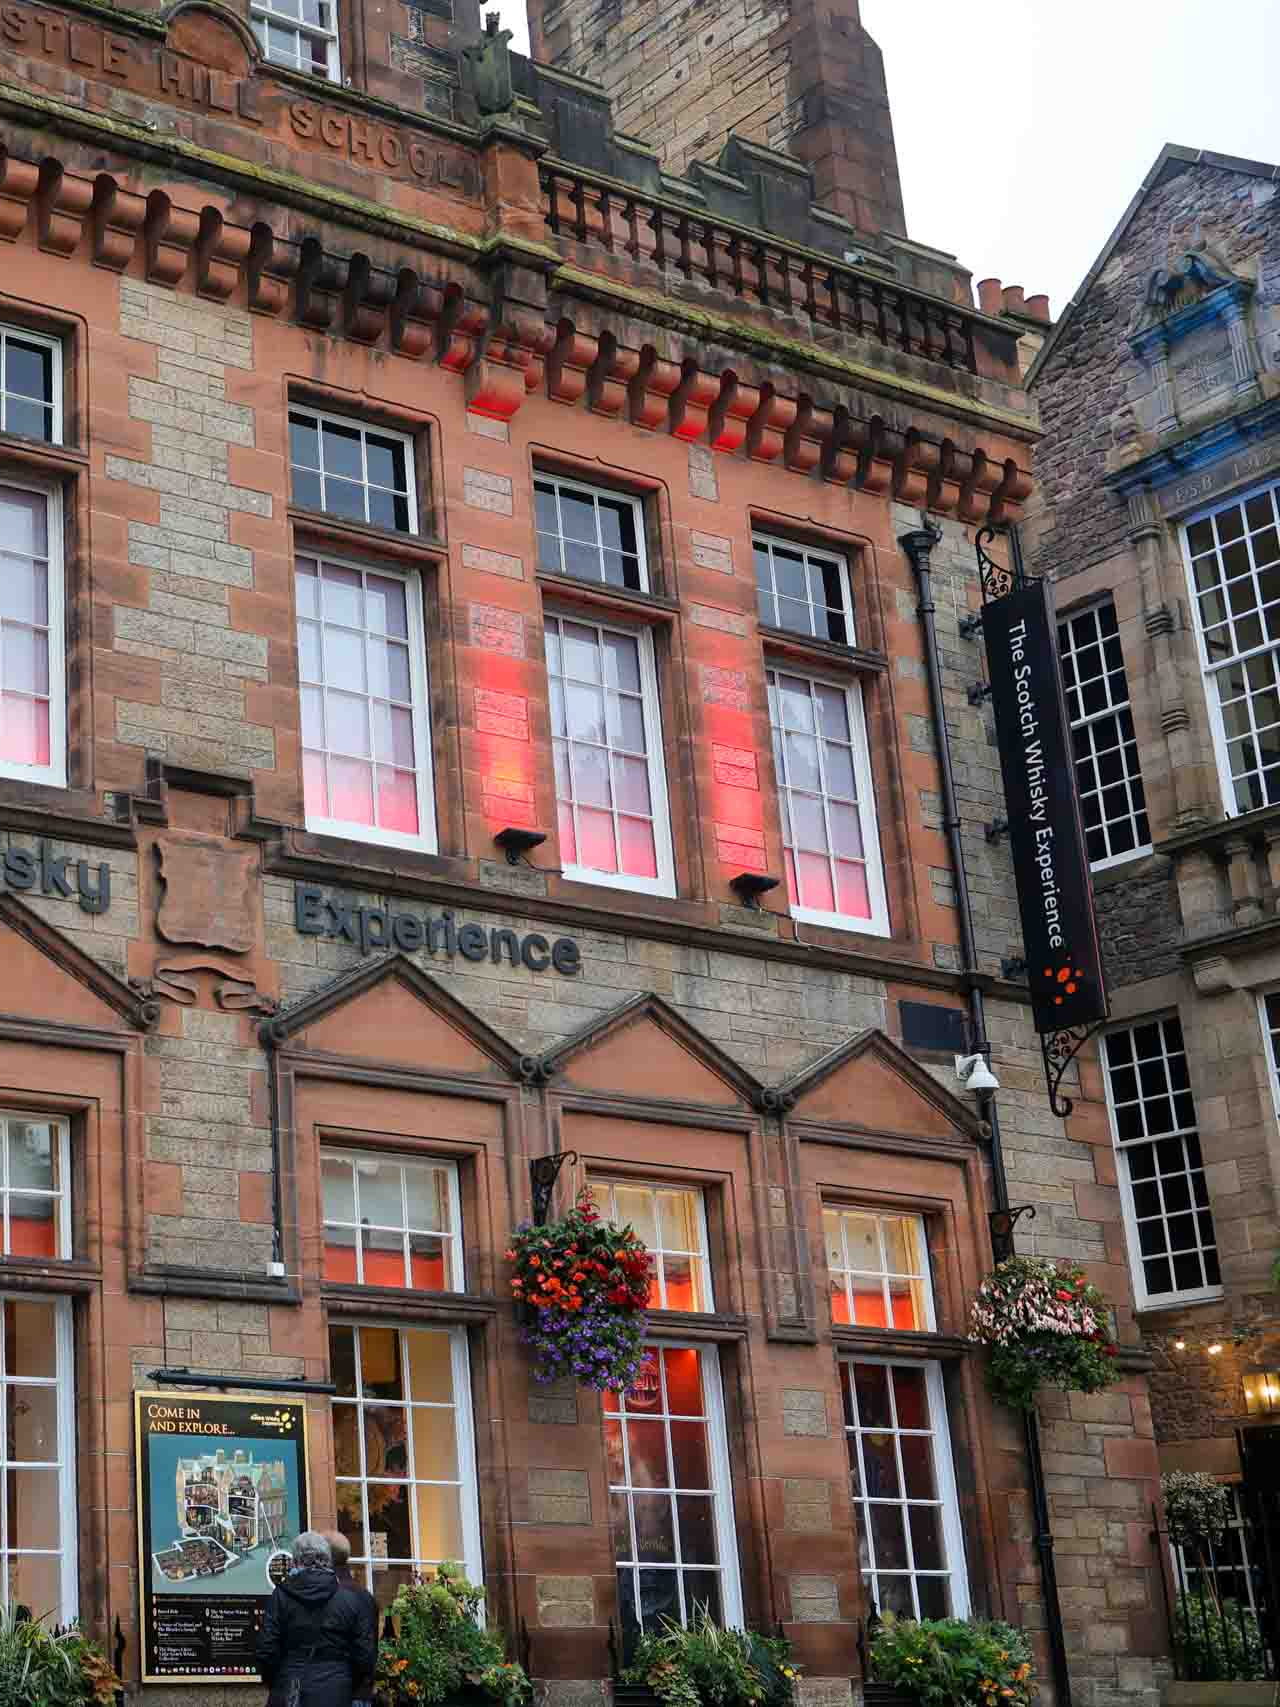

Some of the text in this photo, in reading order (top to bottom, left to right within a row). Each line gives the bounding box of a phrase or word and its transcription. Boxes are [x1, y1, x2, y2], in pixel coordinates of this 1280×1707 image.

[159, 49, 263, 124] HILL
[288, 101, 461, 189] SCHOOL
[1009, 618, 1064, 950] The Scotch Whisky Experience
[294, 878, 581, 976] Experience
[149, 1421, 176, 1433] AND
[187, 1408, 200, 1420] IN
